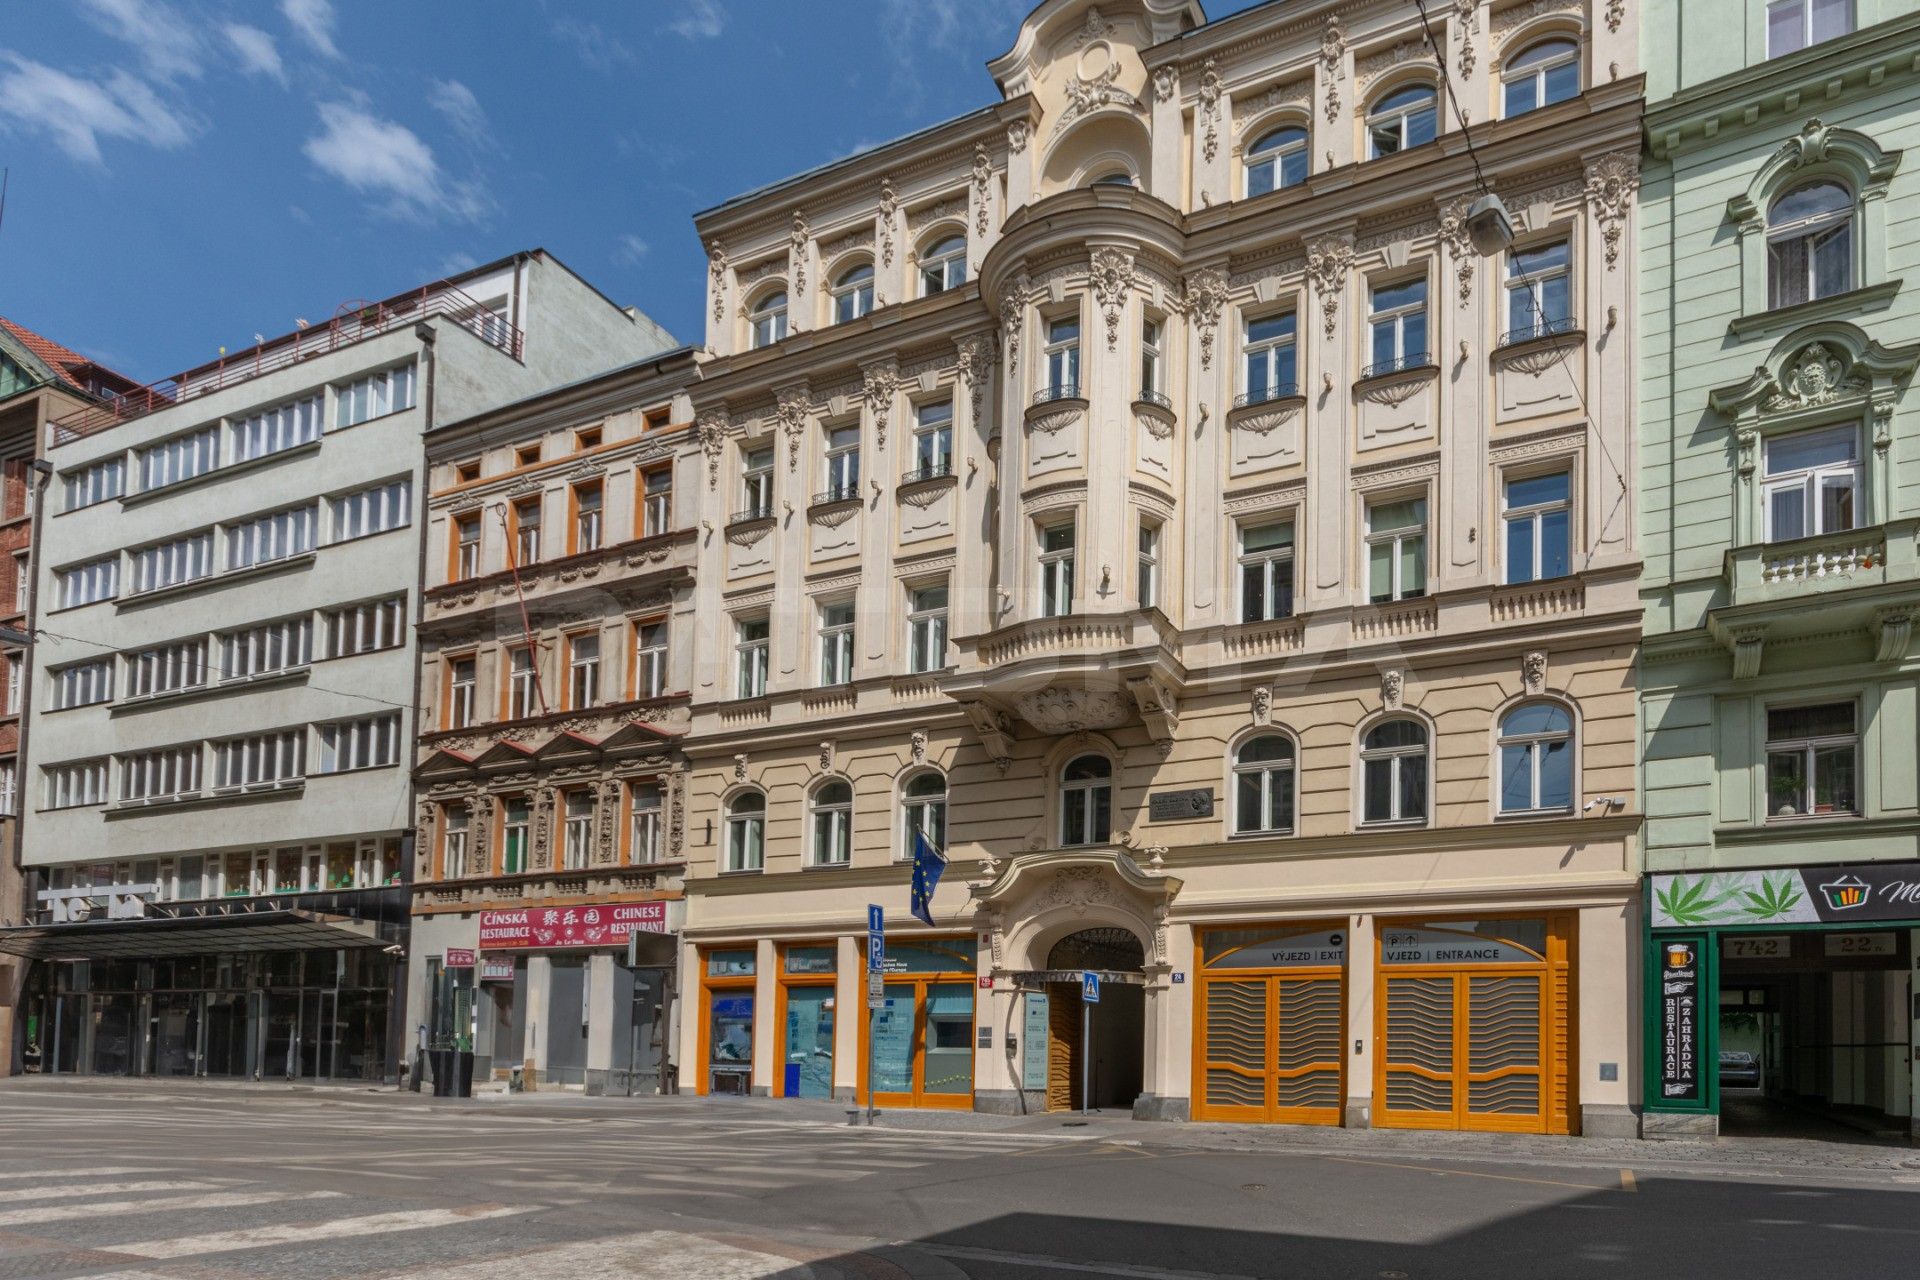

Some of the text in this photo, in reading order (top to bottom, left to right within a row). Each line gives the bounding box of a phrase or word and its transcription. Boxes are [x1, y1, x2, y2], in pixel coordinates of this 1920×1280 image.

[483, 910, 528, 925] ČÍNSKÁ
[613, 906, 661, 920] CHINESE
[481, 927, 530, 939] RESTAURACE
[610, 920, 664, 934] RESTAURANT
[872, 937, 881, 959] P
[1734, 940, 1778, 955] 742
[1272, 950, 1344, 961] VÝJEZD EXIT
[1387, 949, 1500, 961] VJEZD ENTRANCE
[1666, 998, 1676, 1079] RESTAURACE
[1681, 1007, 1692, 1079] ZAHRÁDKA
